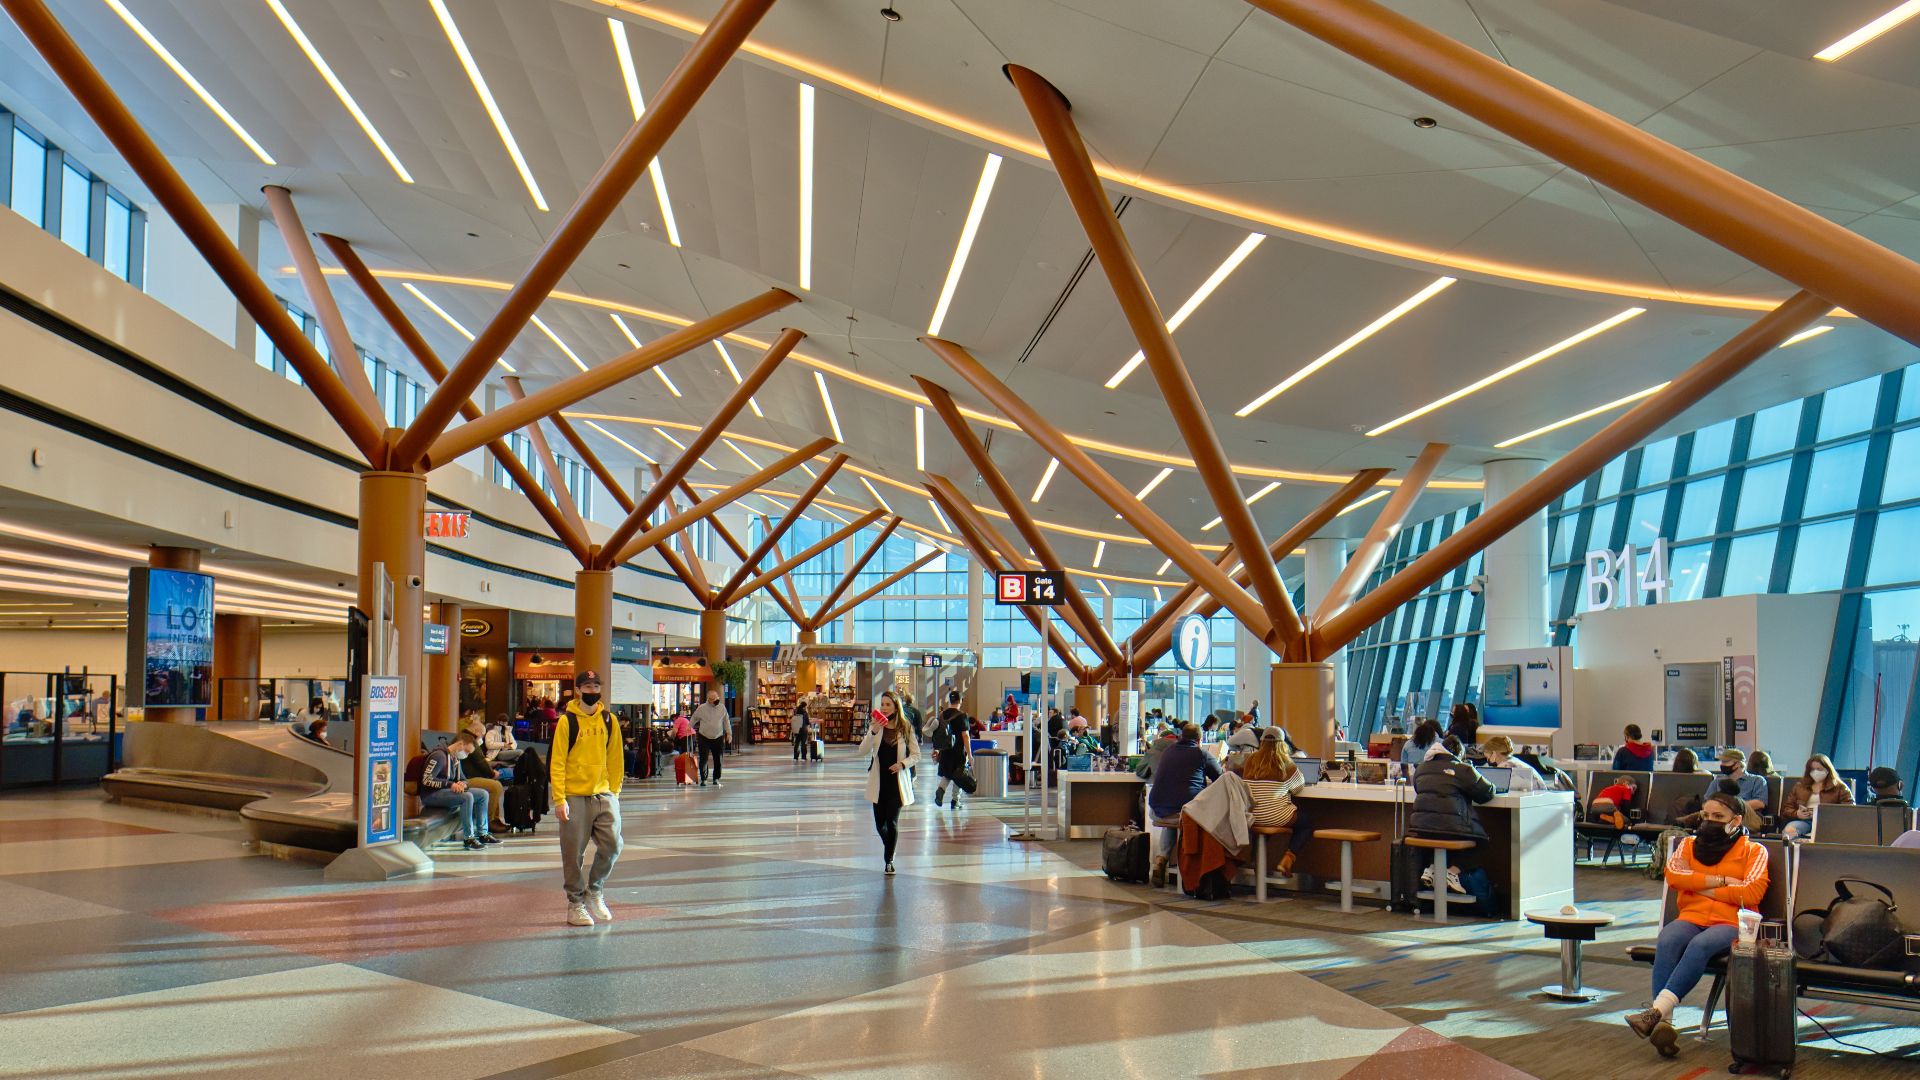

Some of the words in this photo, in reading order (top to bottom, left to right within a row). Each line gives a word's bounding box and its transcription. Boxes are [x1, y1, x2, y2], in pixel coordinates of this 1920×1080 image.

[429, 514, 468, 538] EXIT
[1586, 537, 1673, 612] B14
[1004, 578, 1021, 598] B
[1033, 585, 1055, 599] 14
[370, 685, 398, 699] BOS2GO
